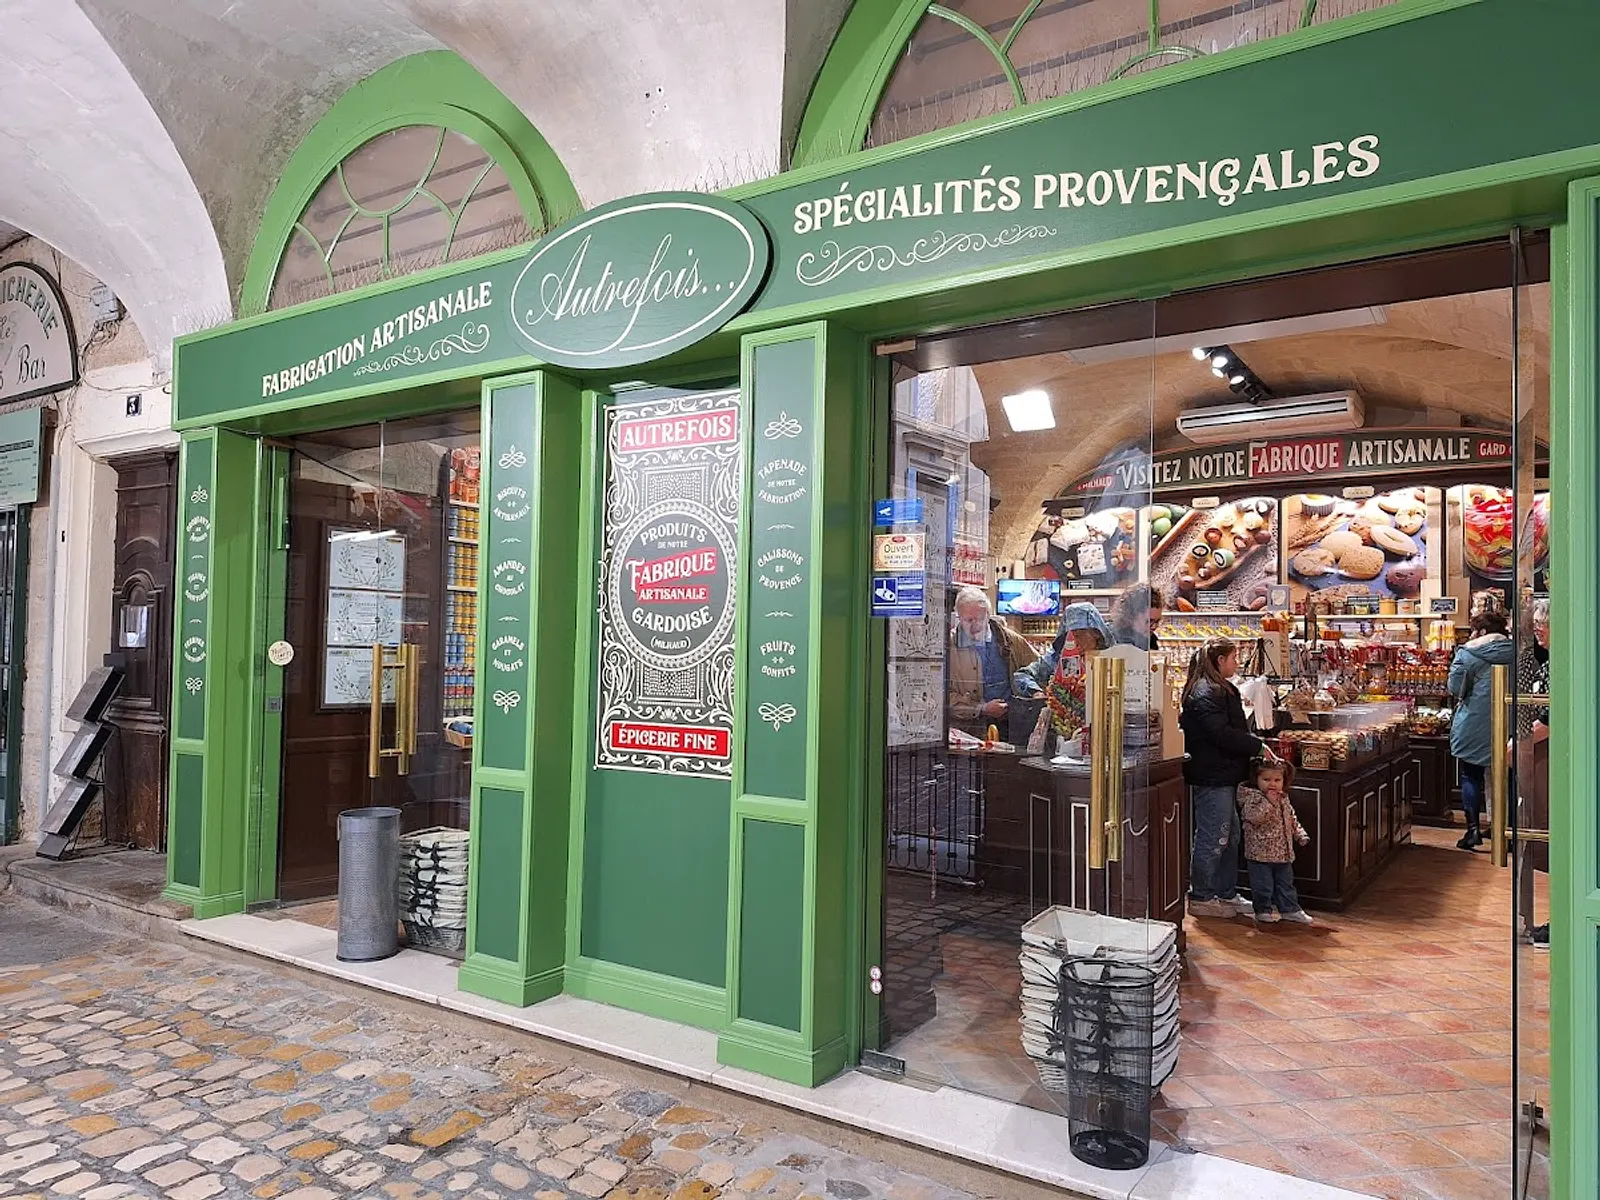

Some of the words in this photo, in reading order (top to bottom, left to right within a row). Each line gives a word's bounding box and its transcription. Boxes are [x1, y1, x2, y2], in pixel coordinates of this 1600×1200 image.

[793, 165, 1021, 235] SPÉCIALITÉS
[1033, 134, 1381, 210] PROVENÇALES
[262, 334, 366, 398] FABRICATION
[370, 281, 493, 353] ARTISANALE
[16, 344, 46, 385] Bar
[622, 415, 732, 448] AUTREFOIS
[758, 458, 807, 480] TAPENADE
[1116, 459, 1181, 490] VISITEZ
[1189, 450, 1245, 480] NOTRE
[1249, 440, 1339, 479] FABRIQUE
[1347, 437, 1471, 467] ARTISANALE
[1480, 442, 1506, 456] GARD
[497, 486, 527, 502] BISCUITS
[758, 486, 807, 504] FABRICATION
[640, 522, 708, 547] PRODUITS
[757, 548, 804, 568] CALISSONS
[884, 544, 914, 553] Ouvert
[493, 560, 526, 578] AMANDES
[625, 552, 716, 593] FABRIQUE
[758, 573, 803, 590] PROVENCE
[639, 588, 707, 601] ARTISANALE
[632, 605, 713, 633] GARDOISE
[491, 635, 525, 651] CARAMELS
[760, 640, 796, 656] FRUITS
[492, 657, 524, 672] NOUGATS
[761, 665, 796, 678] CONFITS
[618, 723, 680, 748] ÉPICERIE
[684, 733, 717, 751] FINE
